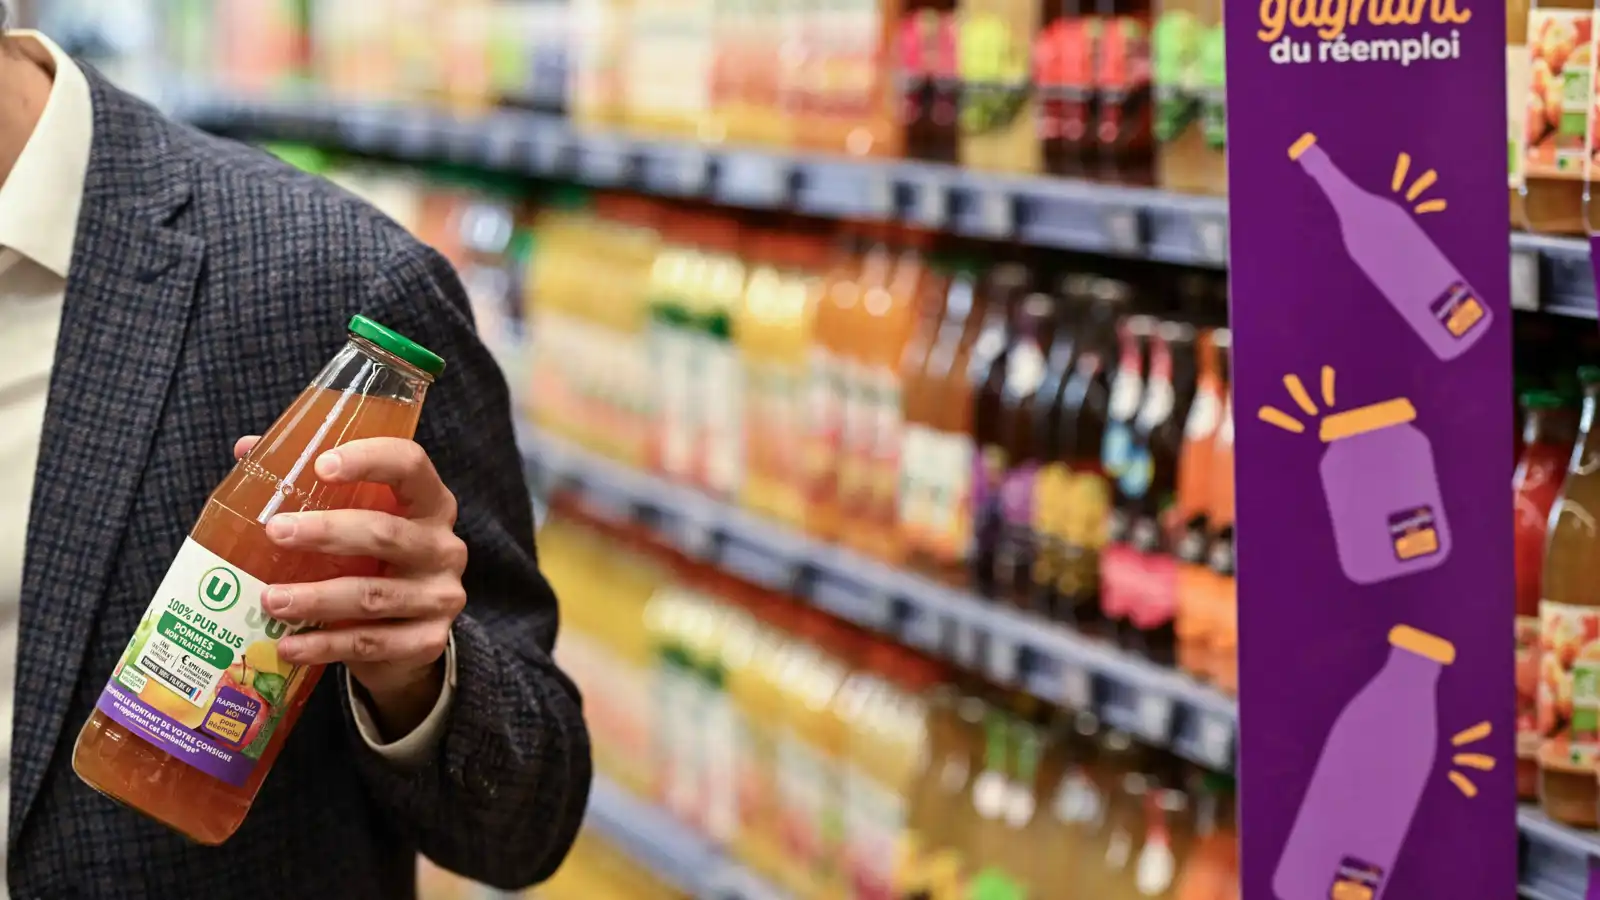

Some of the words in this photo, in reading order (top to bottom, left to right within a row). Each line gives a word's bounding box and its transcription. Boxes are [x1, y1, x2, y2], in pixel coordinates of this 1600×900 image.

[1270, 36, 1311, 63] du
[1318, 29, 1460, 66] réemploi
[206, 575, 232, 602] U
[164, 628, 179, 641] NON
[167, 597, 194, 621] 100%
[193, 613, 218, 635] PUR
[218, 628, 244, 649] JUS
[174, 622, 215, 651] POMMES
[118, 704, 150, 728] rapportant
[149, 721, 160, 734] cet
[215, 698, 257, 718] RAPPORTEZ
[129, 699, 161, 726] MONTANT
[160, 718, 171, 730] DE
[171, 724, 195, 744] VOTRE
[196, 739, 233, 763] CONSIGNE
[207, 721, 241, 738] Réemploi
[219, 718, 237, 729] pour
